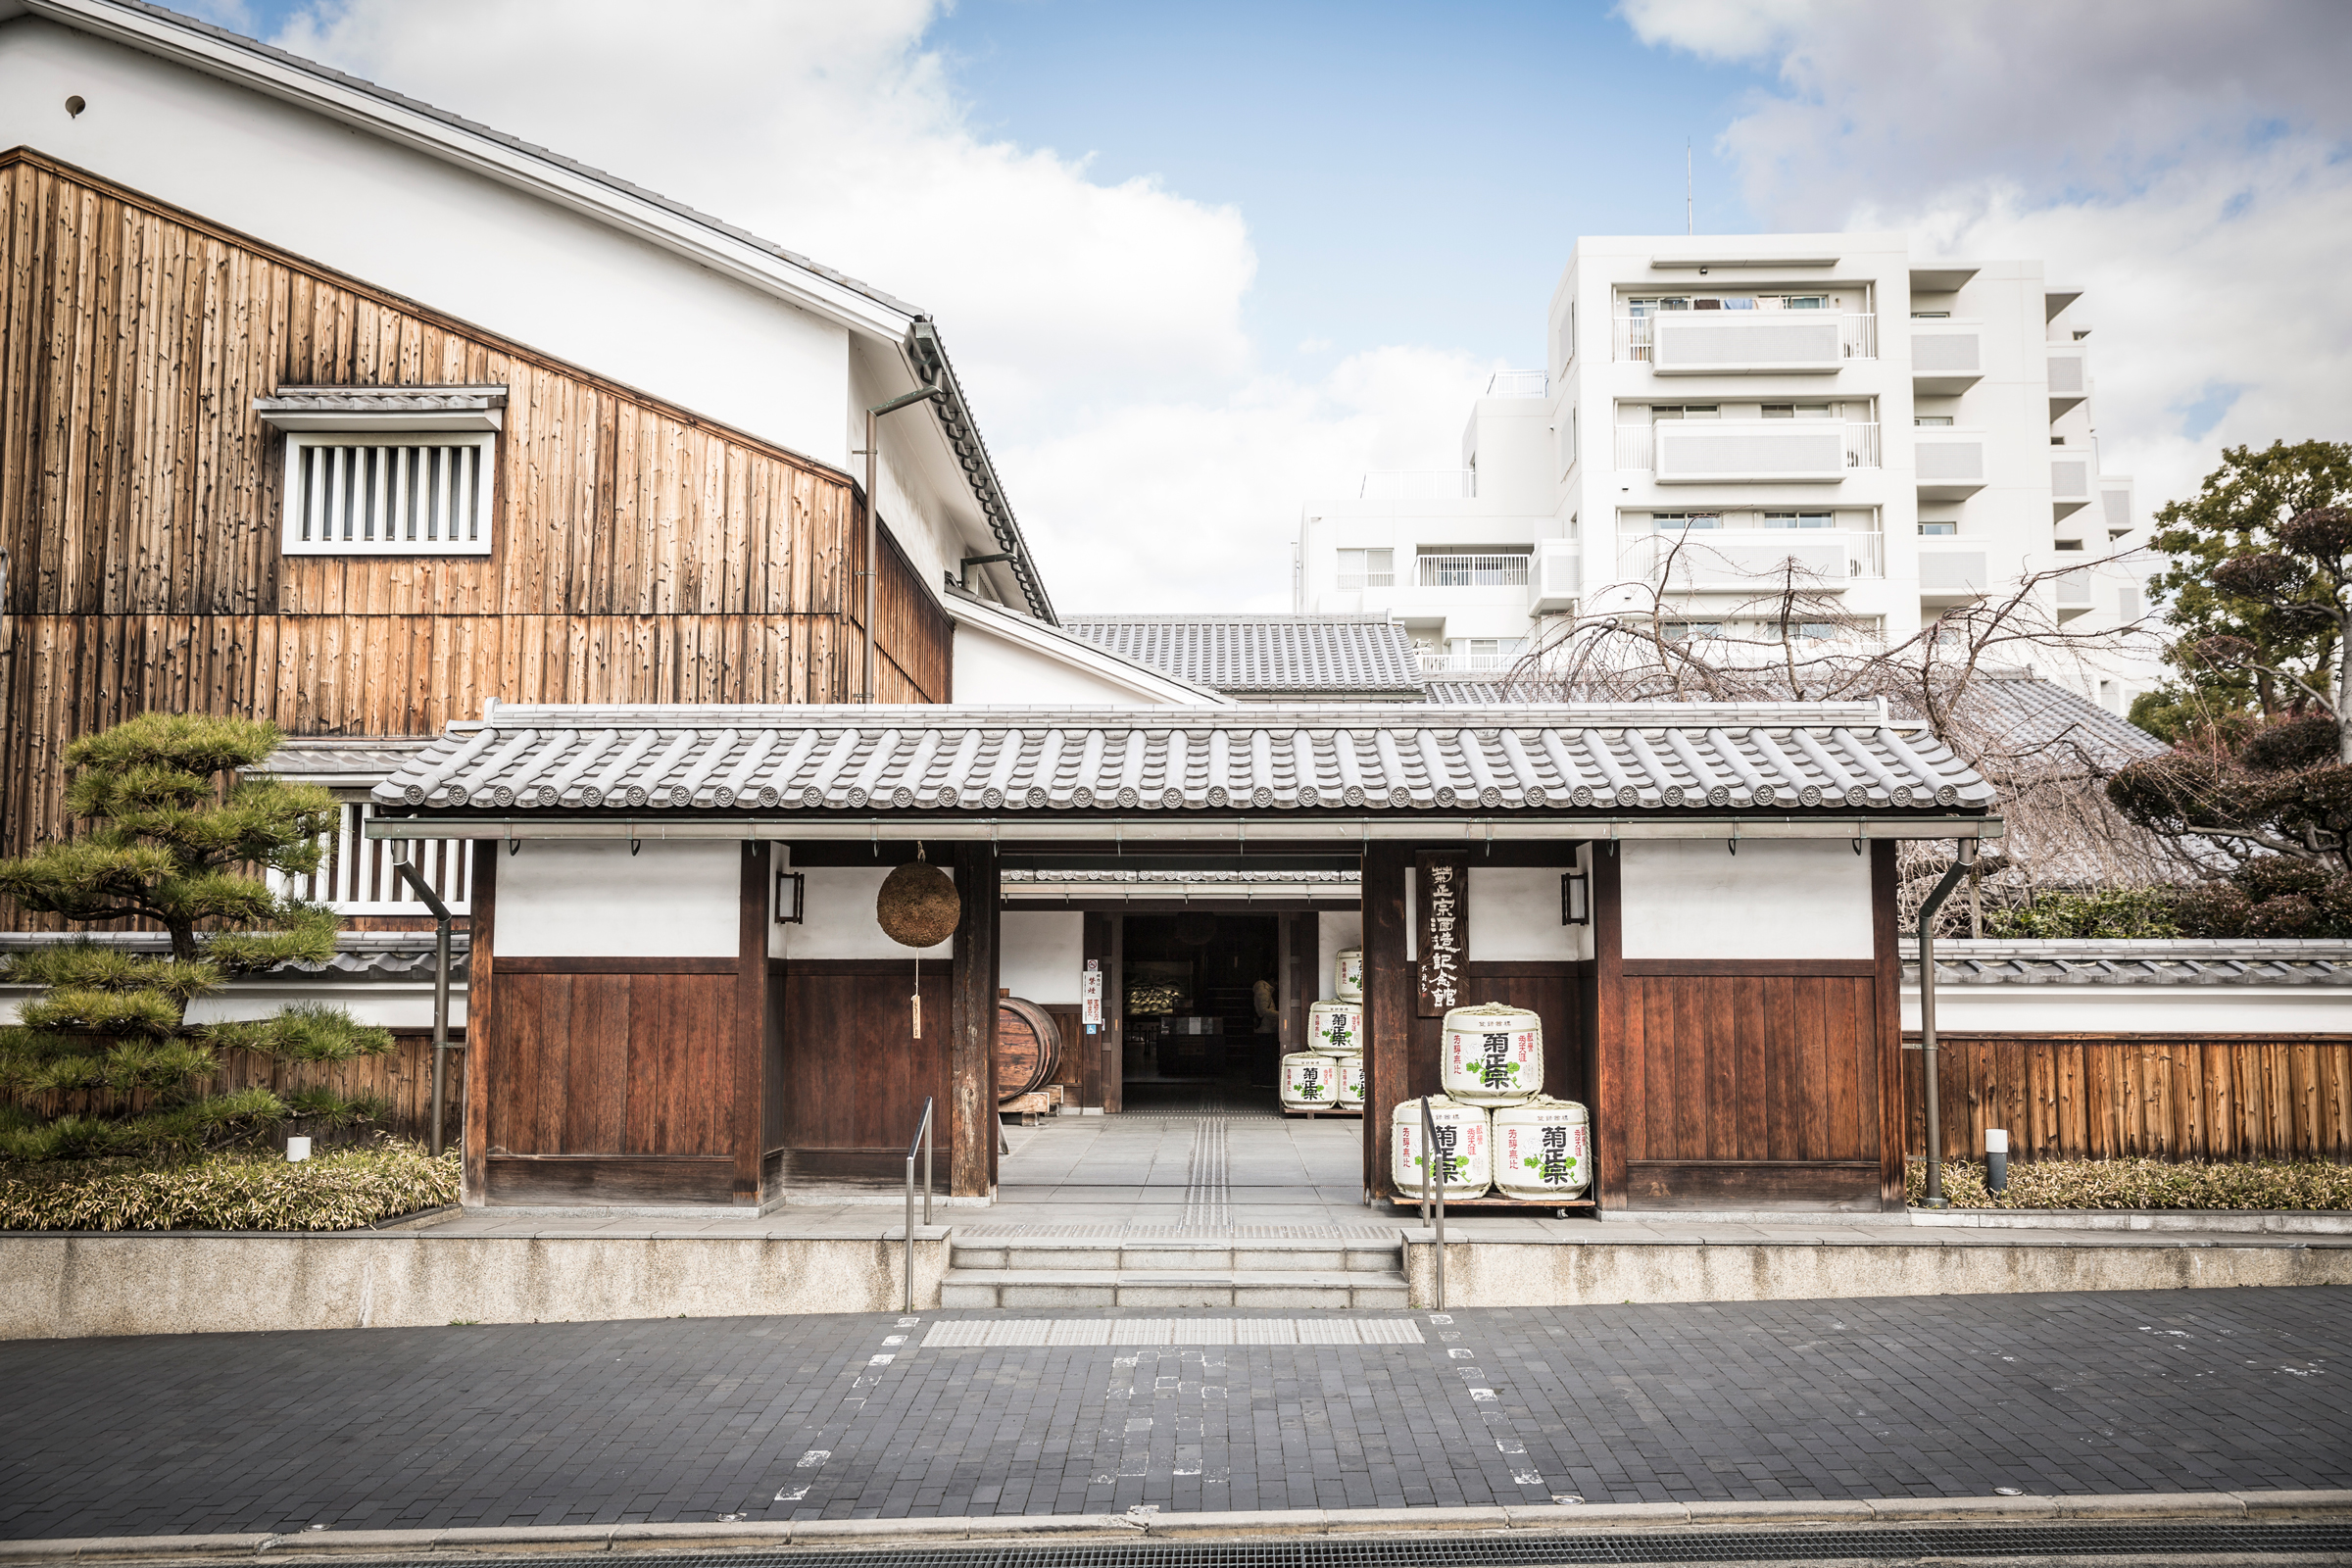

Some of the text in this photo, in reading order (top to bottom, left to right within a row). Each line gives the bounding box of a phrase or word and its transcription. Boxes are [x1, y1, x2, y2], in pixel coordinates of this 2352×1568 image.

[1429, 865, 1460, 1007] 菊正宗酒造記念館
[1331, 1013, 1348, 1047] 菊正宗
[1302, 1067, 1318, 1101] 菊正宗
[1483, 1032, 1510, 1090] 菊正宗
[1541, 1125, 1569, 1185] 菊正宗
